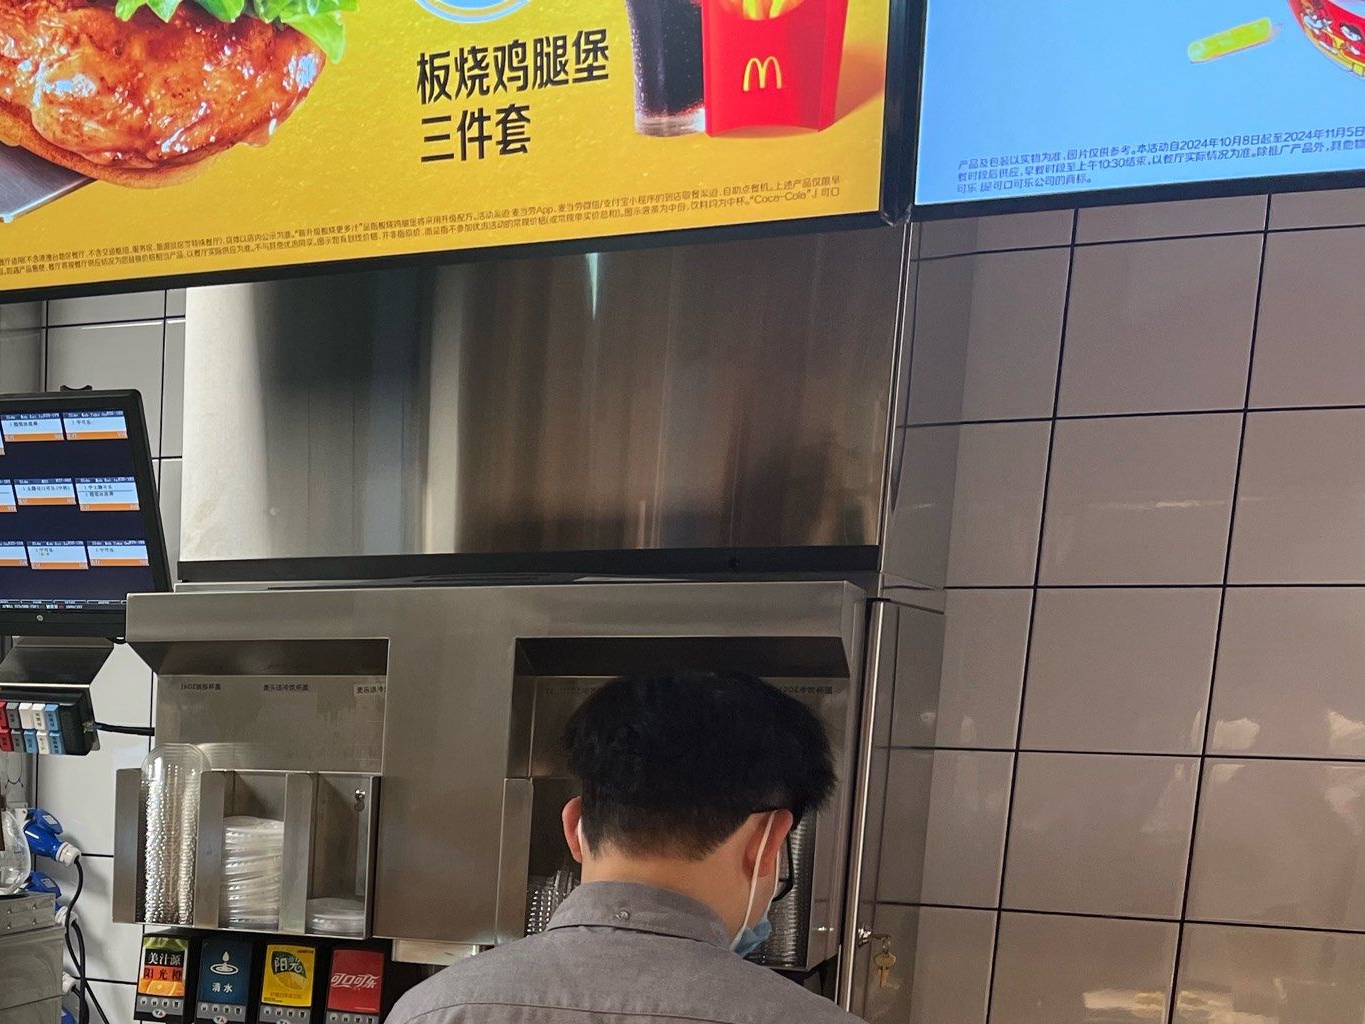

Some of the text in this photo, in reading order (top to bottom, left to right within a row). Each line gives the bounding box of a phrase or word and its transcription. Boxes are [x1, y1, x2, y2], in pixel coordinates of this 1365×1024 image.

[416, 29, 609, 105] 板烧鸡腿堡
[420, 103, 532, 163] 三件套
[148, 951, 181, 966] 美汁源
[274, 956, 303, 974] 阳光
[211, 981, 233, 994] 清水
[330, 972, 381, 989] 可口可乐
